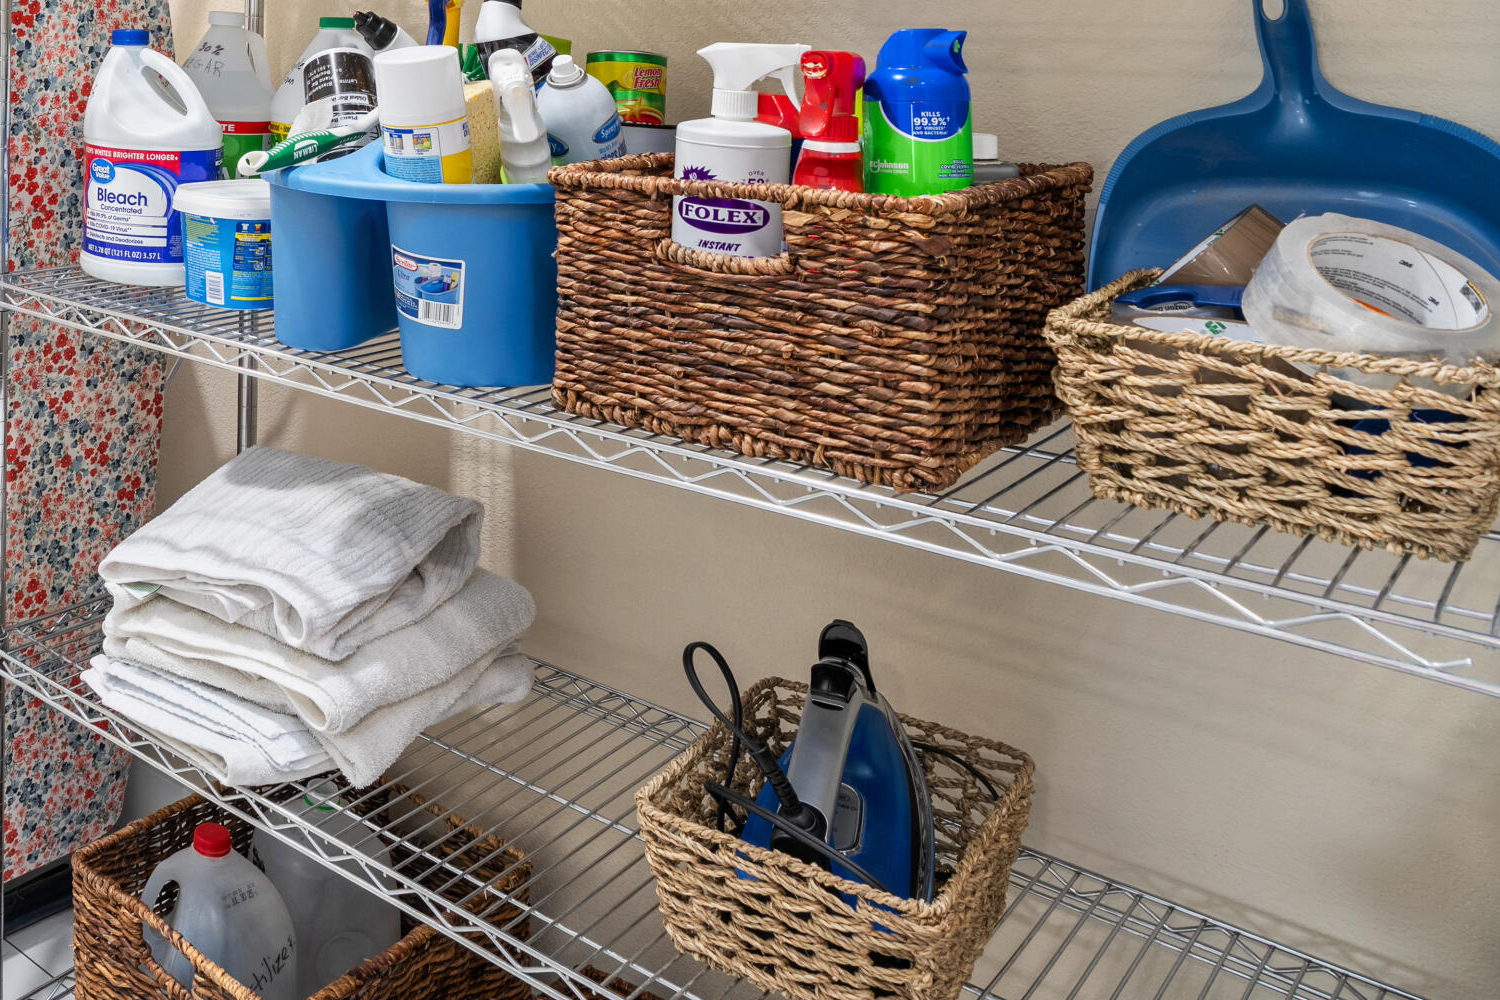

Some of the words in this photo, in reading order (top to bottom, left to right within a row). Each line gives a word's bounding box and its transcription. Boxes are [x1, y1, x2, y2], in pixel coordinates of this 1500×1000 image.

[634, 67, 662, 78] Lemon
[634, 77, 661, 89] Fresh
[113, 151, 145, 160] BRIGHTER
[294, 144, 318, 160] LIBMAN
[91, 162, 110, 173] Great
[95, 171, 110, 180] Value
[97, 187, 148, 206] Bleach
[100, 203, 143, 215] Concentrated
[684, 203, 758, 224] FOLEX
[698, 239, 742, 252] INSTANT
